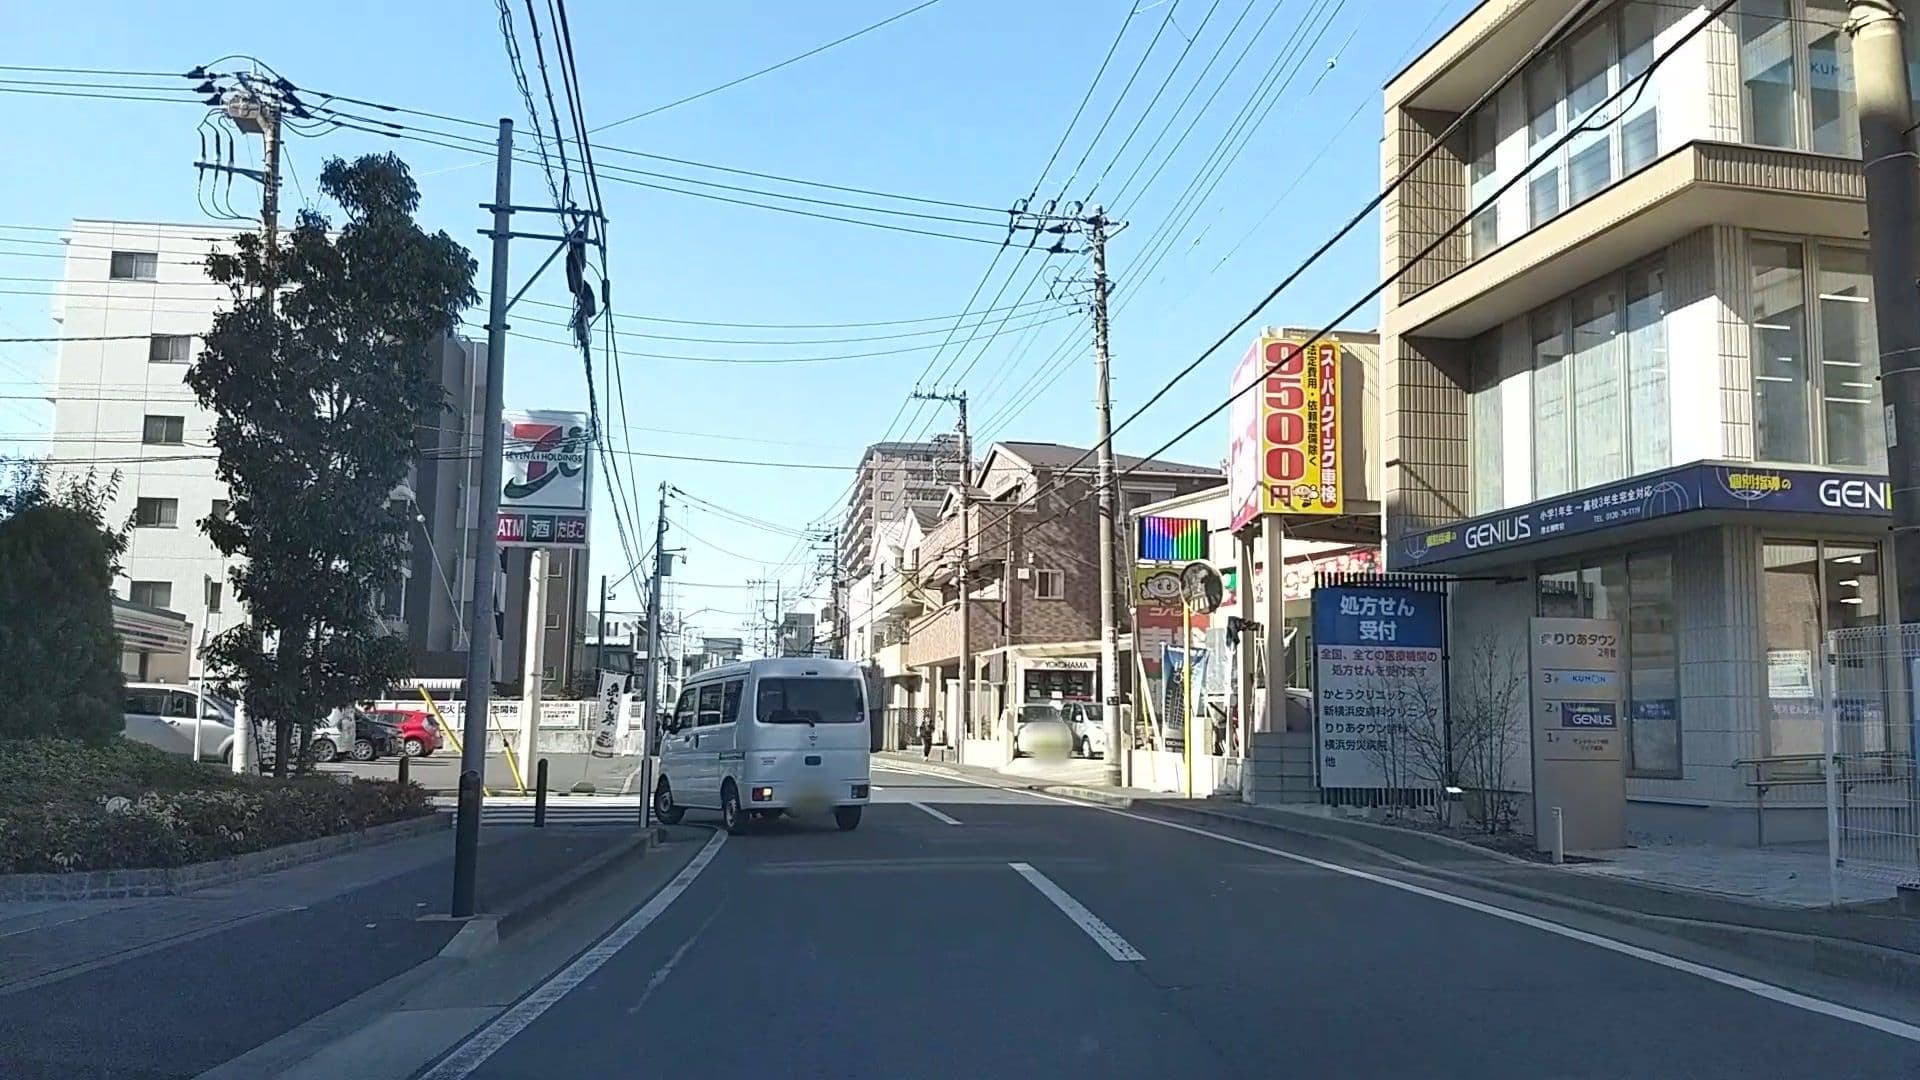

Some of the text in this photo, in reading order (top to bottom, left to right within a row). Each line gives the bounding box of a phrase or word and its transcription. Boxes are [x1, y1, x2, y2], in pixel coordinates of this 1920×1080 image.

[541, 452, 583, 462] HOLDINGS
[497, 518, 524, 537] ATM
[531, 519, 551, 539] 酒
[557, 521, 585, 539] たばこ
[1465, 514, 1531, 549] GENIUS
[1340, 595, 1415, 617] 処方せん
[1359, 620, 1398, 642] 受付
[1554, 633, 1616, 646] りりあタウン
[1321, 648, 1438, 662] 全国、全ての医療機関の
[1044, 661, 1089, 669] YOKOHAMA
[1572, 674, 1606, 684] KUMON
[1323, 689, 1406, 701] かとうクリニック
[1324, 706, 1438, 718] 新横浜皮膚科クリニック
[1572, 714, 1613, 725] GENIUS
[1325, 739, 1388, 751] 横浜労災病院
[1325, 756, 1336, 768] 他
